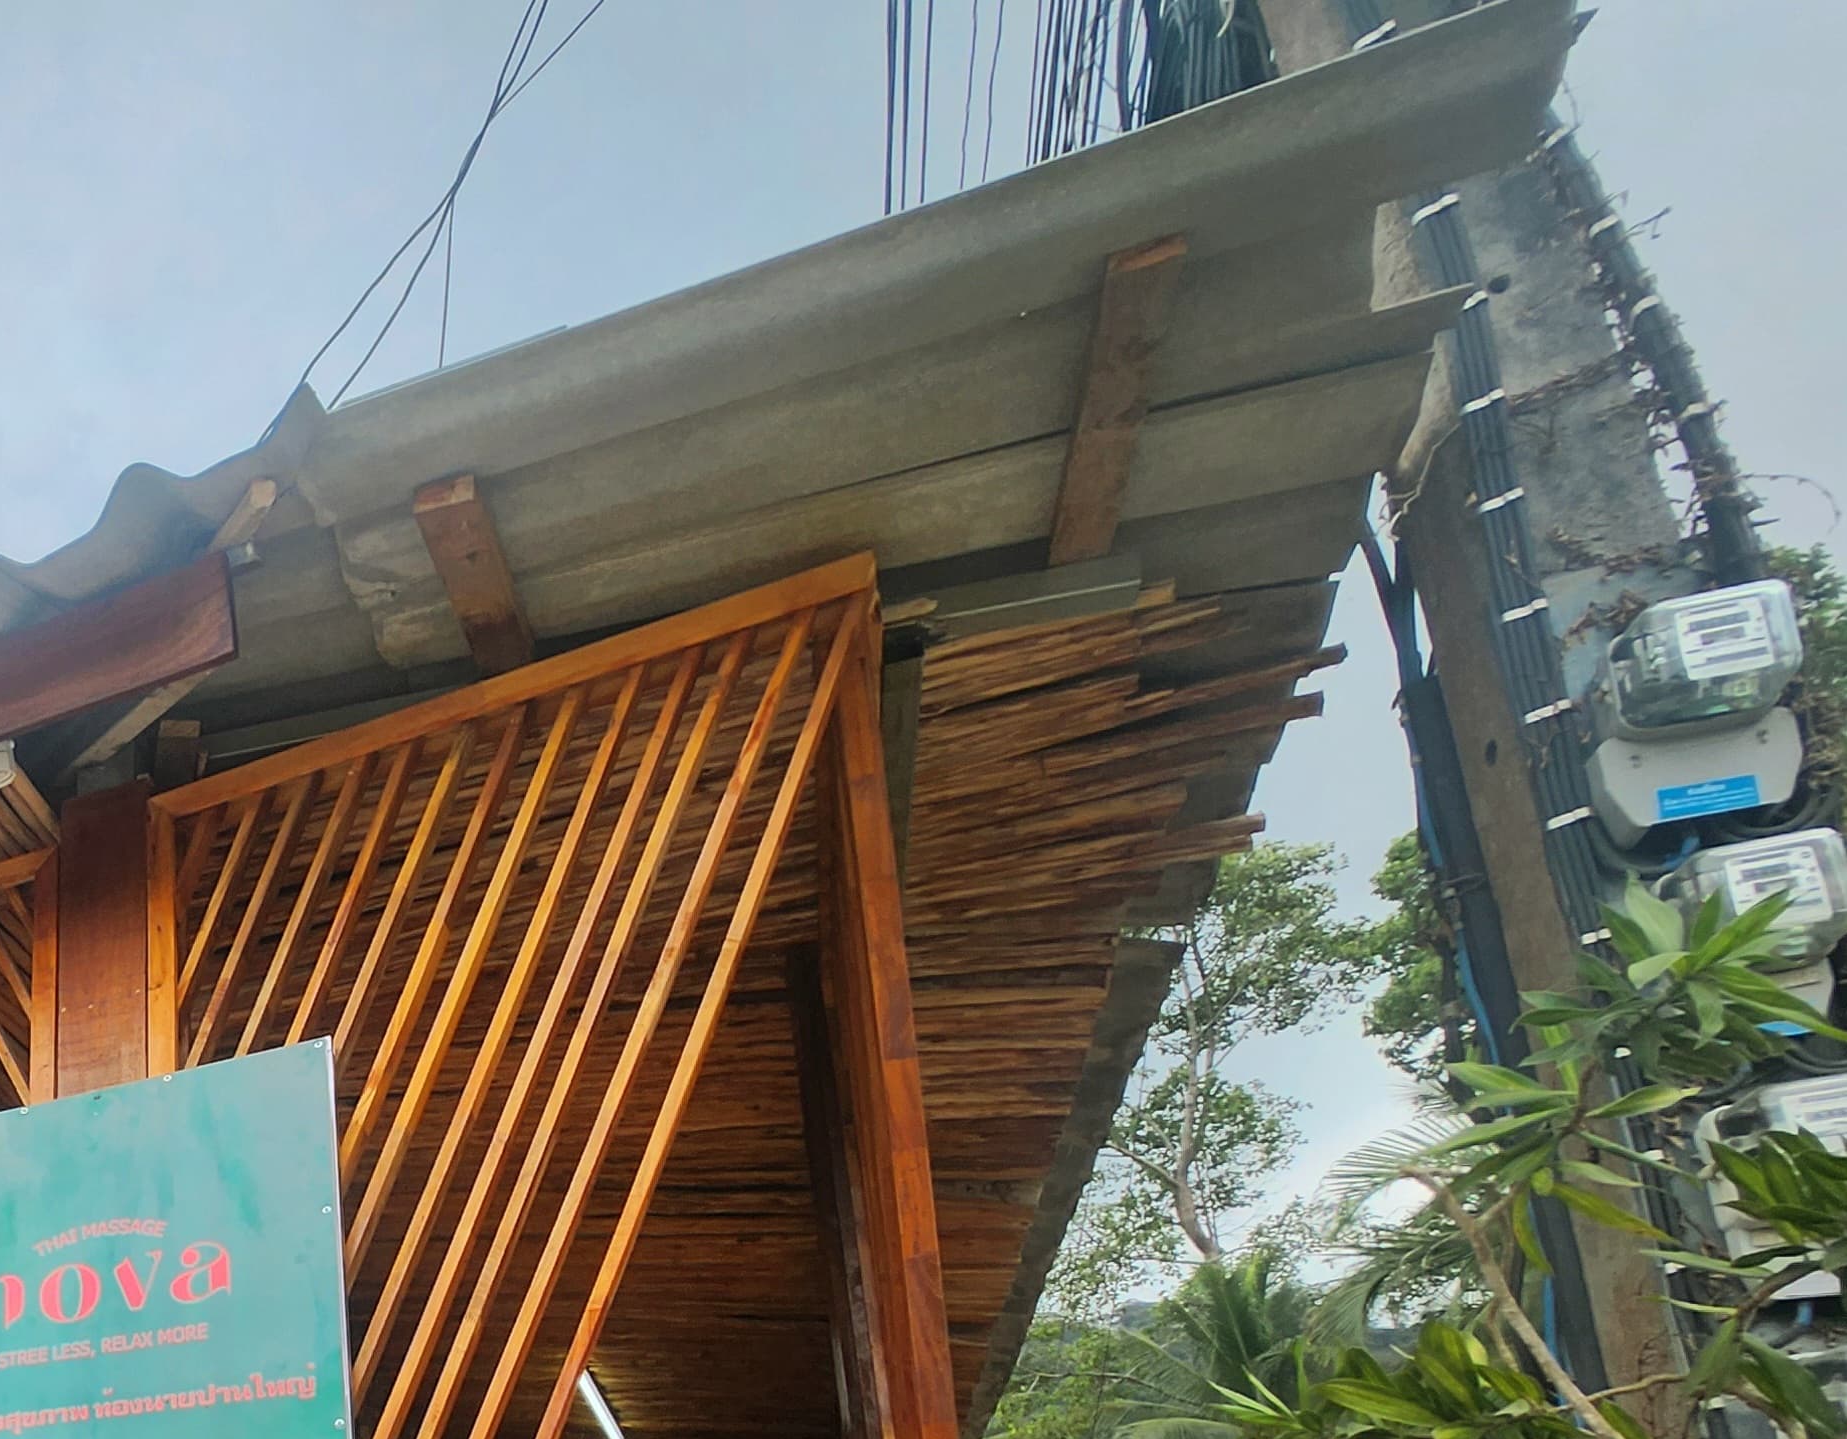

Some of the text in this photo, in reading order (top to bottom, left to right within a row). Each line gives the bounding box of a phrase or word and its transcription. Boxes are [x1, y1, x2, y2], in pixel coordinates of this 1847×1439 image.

[32, 1217, 168, 1257] THAI MASSAGE
[52, 1340, 96, 1361] LESS,
[101, 1330, 154, 1354] RELAX
[157, 1322, 209, 1345] MORE
